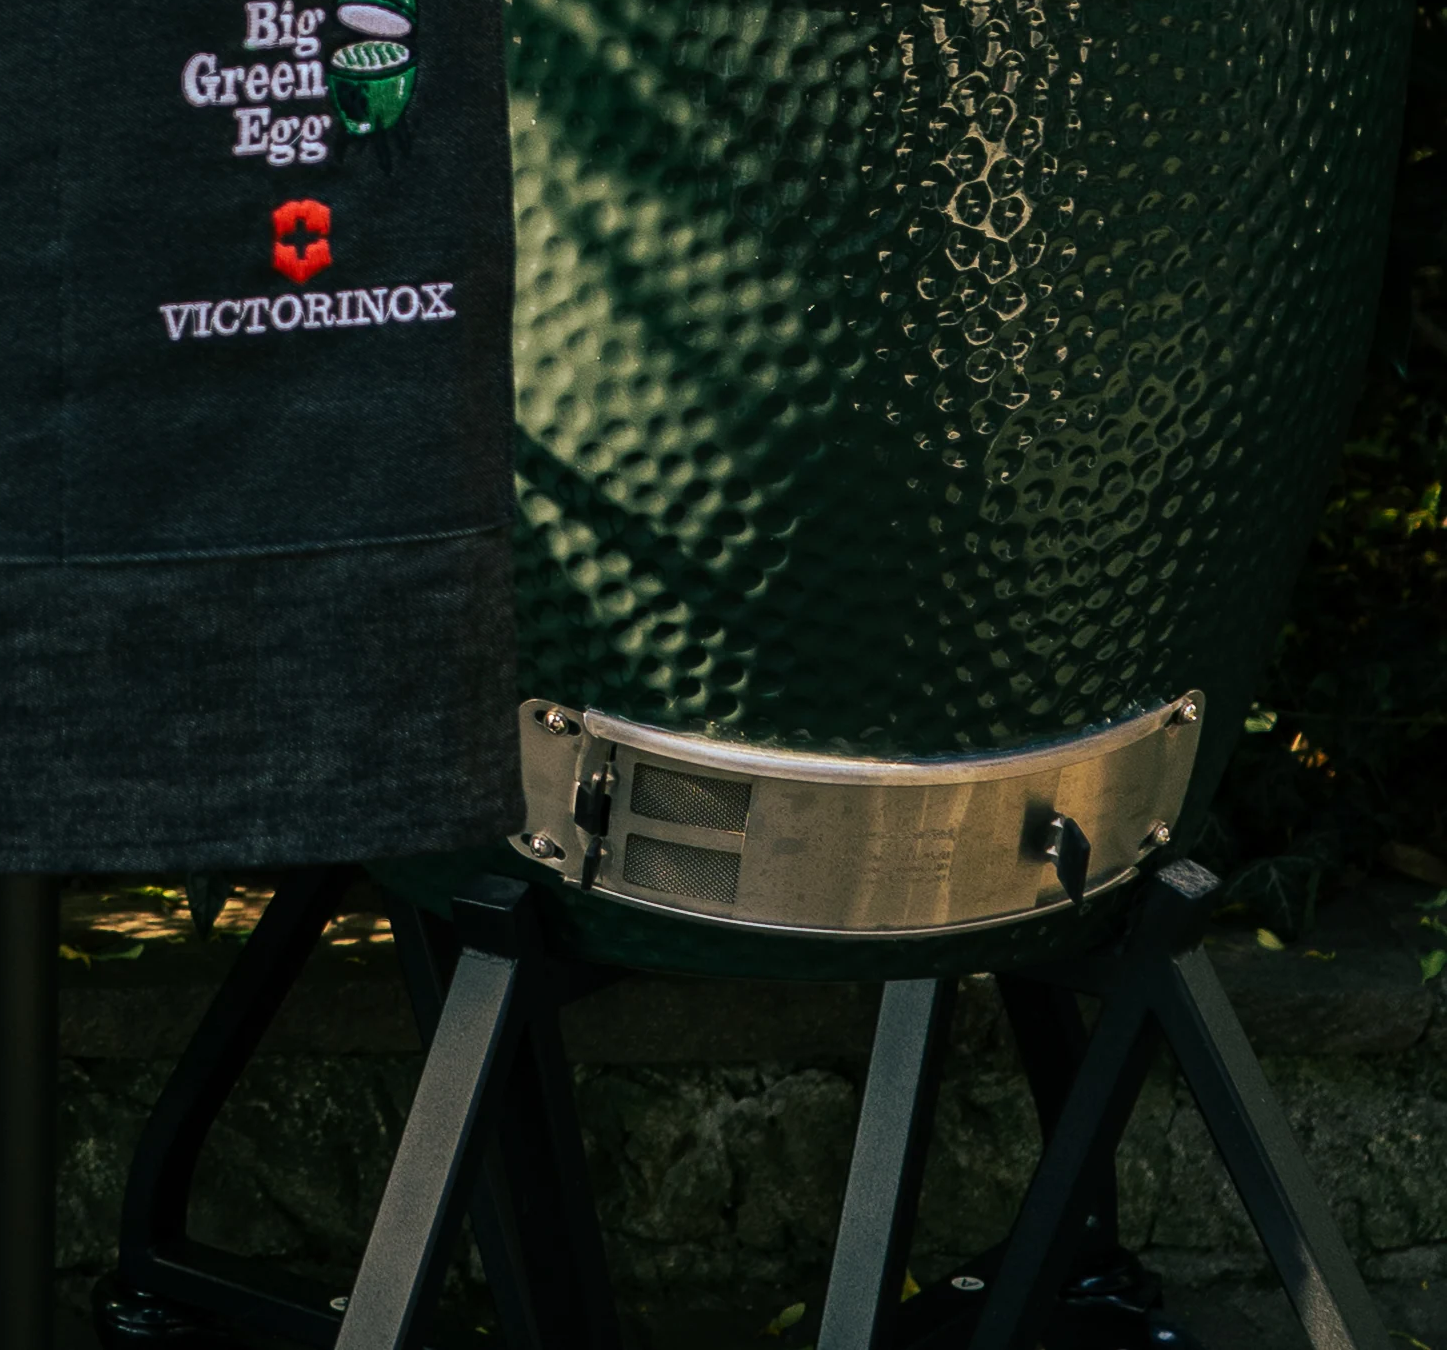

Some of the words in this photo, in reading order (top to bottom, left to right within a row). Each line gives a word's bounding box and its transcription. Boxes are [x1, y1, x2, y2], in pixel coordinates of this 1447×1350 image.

[243, 0, 325, 57] Big
[182, 52, 328, 107] Green
[233, 106, 332, 166] Egg
[160, 283, 456, 341] VICTORINOX
